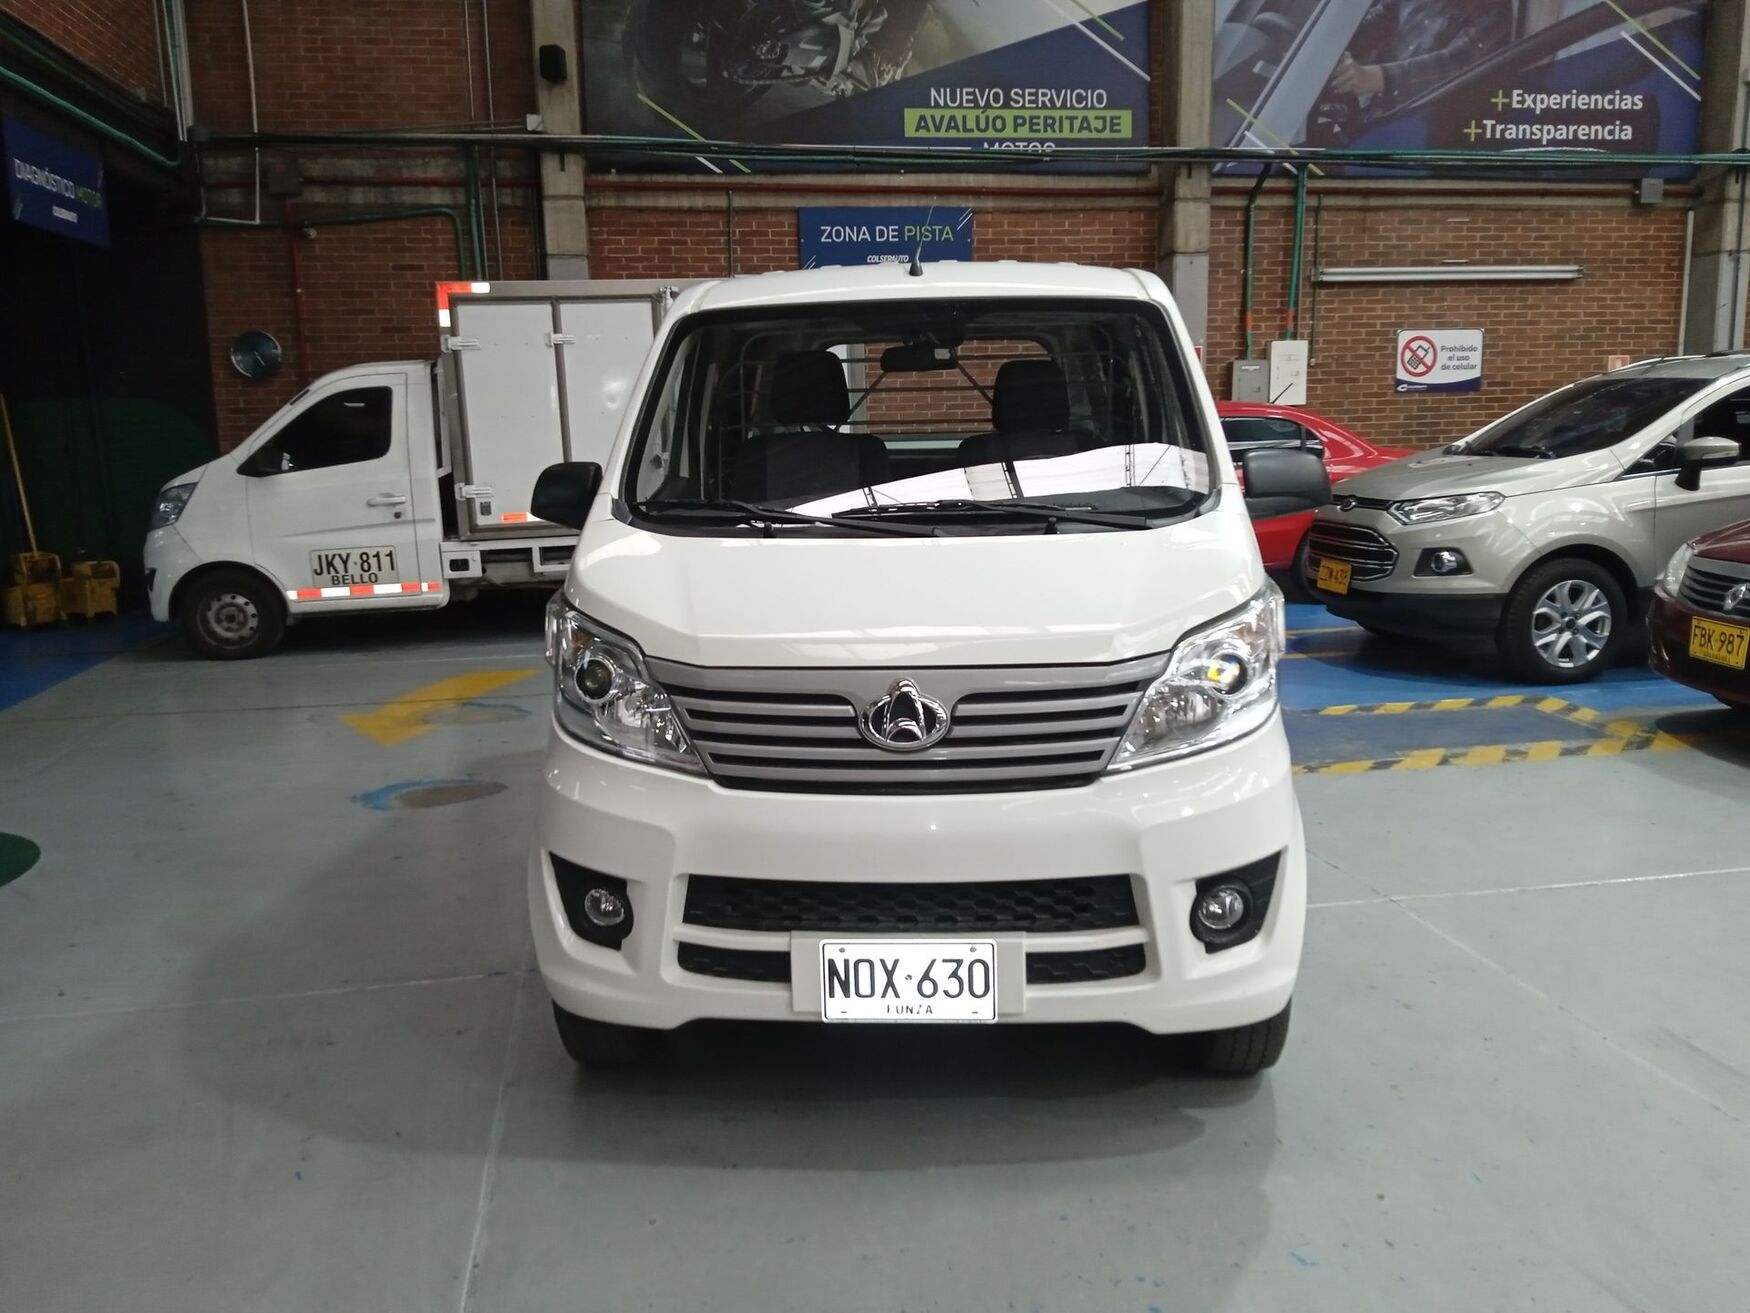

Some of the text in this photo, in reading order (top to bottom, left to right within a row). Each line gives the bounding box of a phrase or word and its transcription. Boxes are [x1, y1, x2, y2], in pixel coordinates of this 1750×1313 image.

[930, 87, 1107, 109] NUEVO SERVICIO
[914, 109, 1123, 134] AVALÚO PERITAJE
[820, 226, 954, 243] ZONA DE PISTA
[1440, 344, 1478, 353] Prohibido
[1447, 353, 1471, 362] el uso
[1440, 362, 1478, 371] de celular
[330, 571, 379, 586] BELLO
